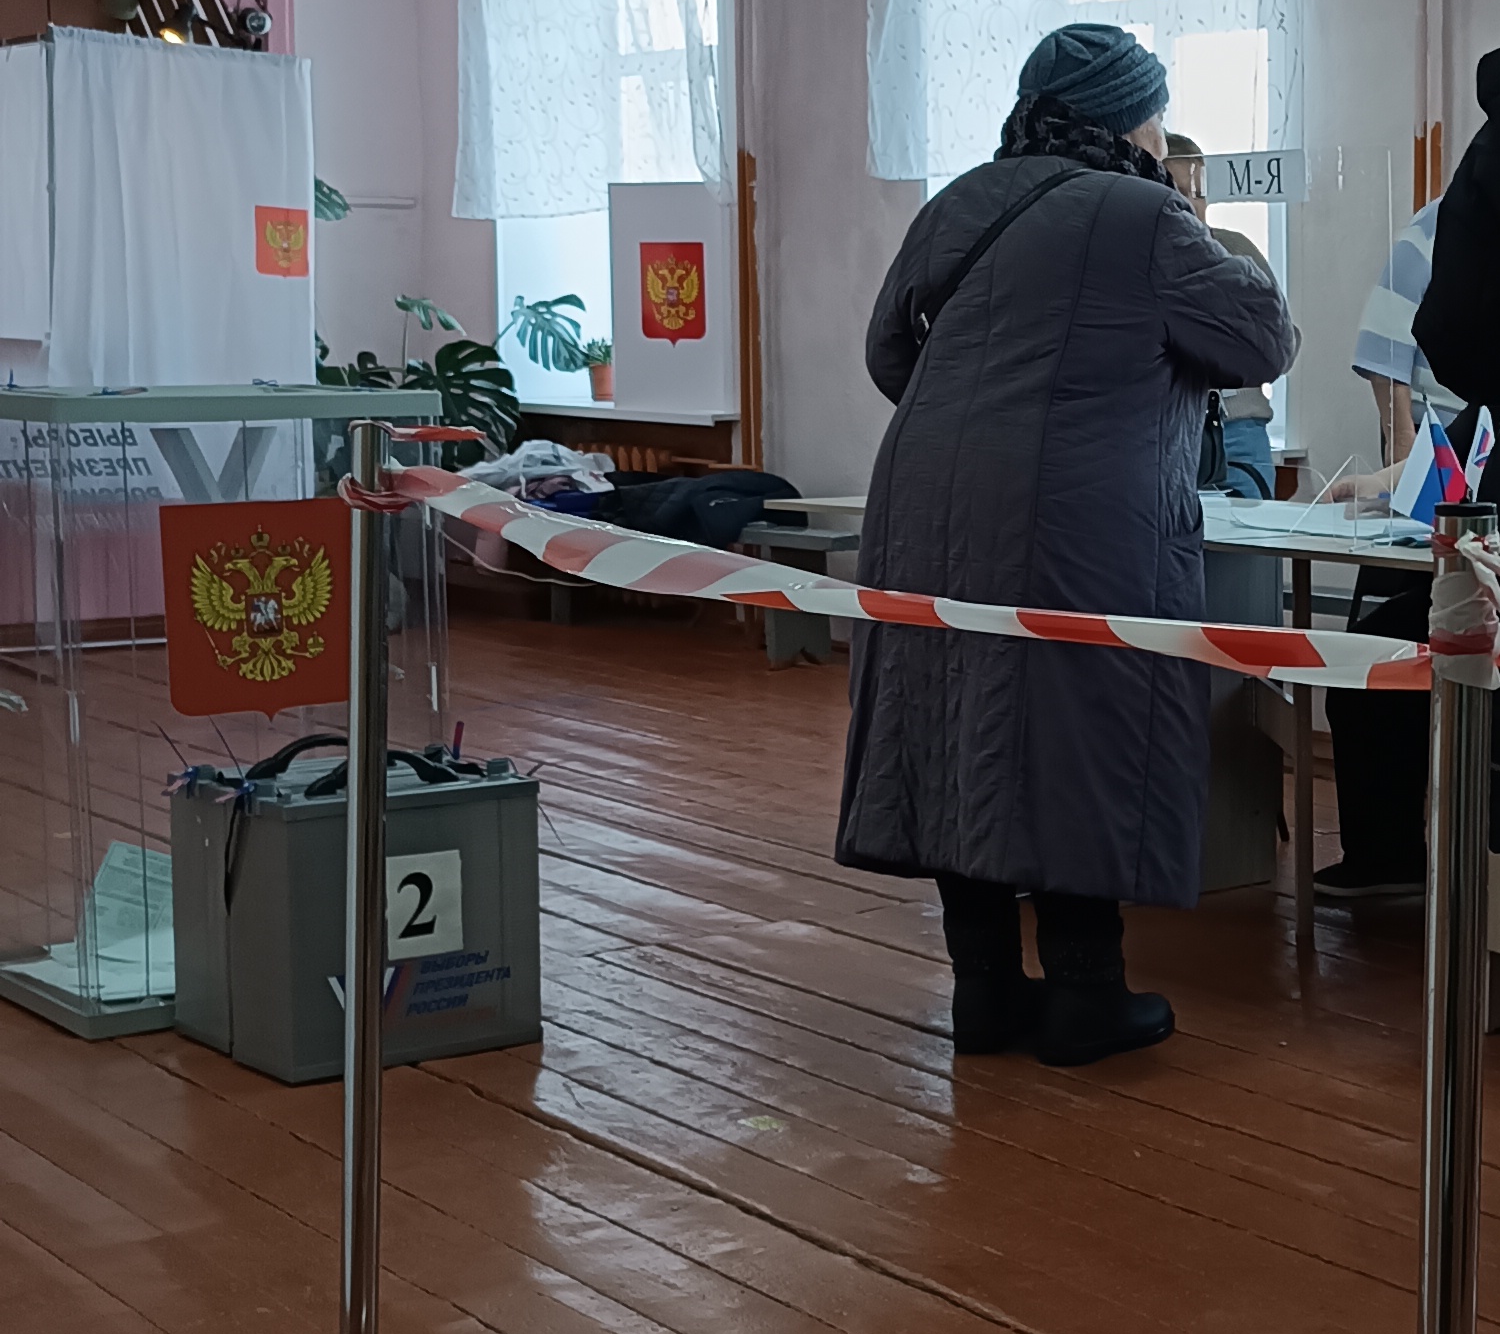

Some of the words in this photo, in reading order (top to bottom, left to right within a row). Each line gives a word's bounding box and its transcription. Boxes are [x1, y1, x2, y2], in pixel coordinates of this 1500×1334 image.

[1227, 157, 1284, 195] М-Я
[397, 872, 437, 939] 2
[420, 950, 490, 974] ВЫБОРЫ
[412, 966, 511, 996] ПРЕЗИДЕНТА
[406, 993, 469, 1017] РОССИИ
